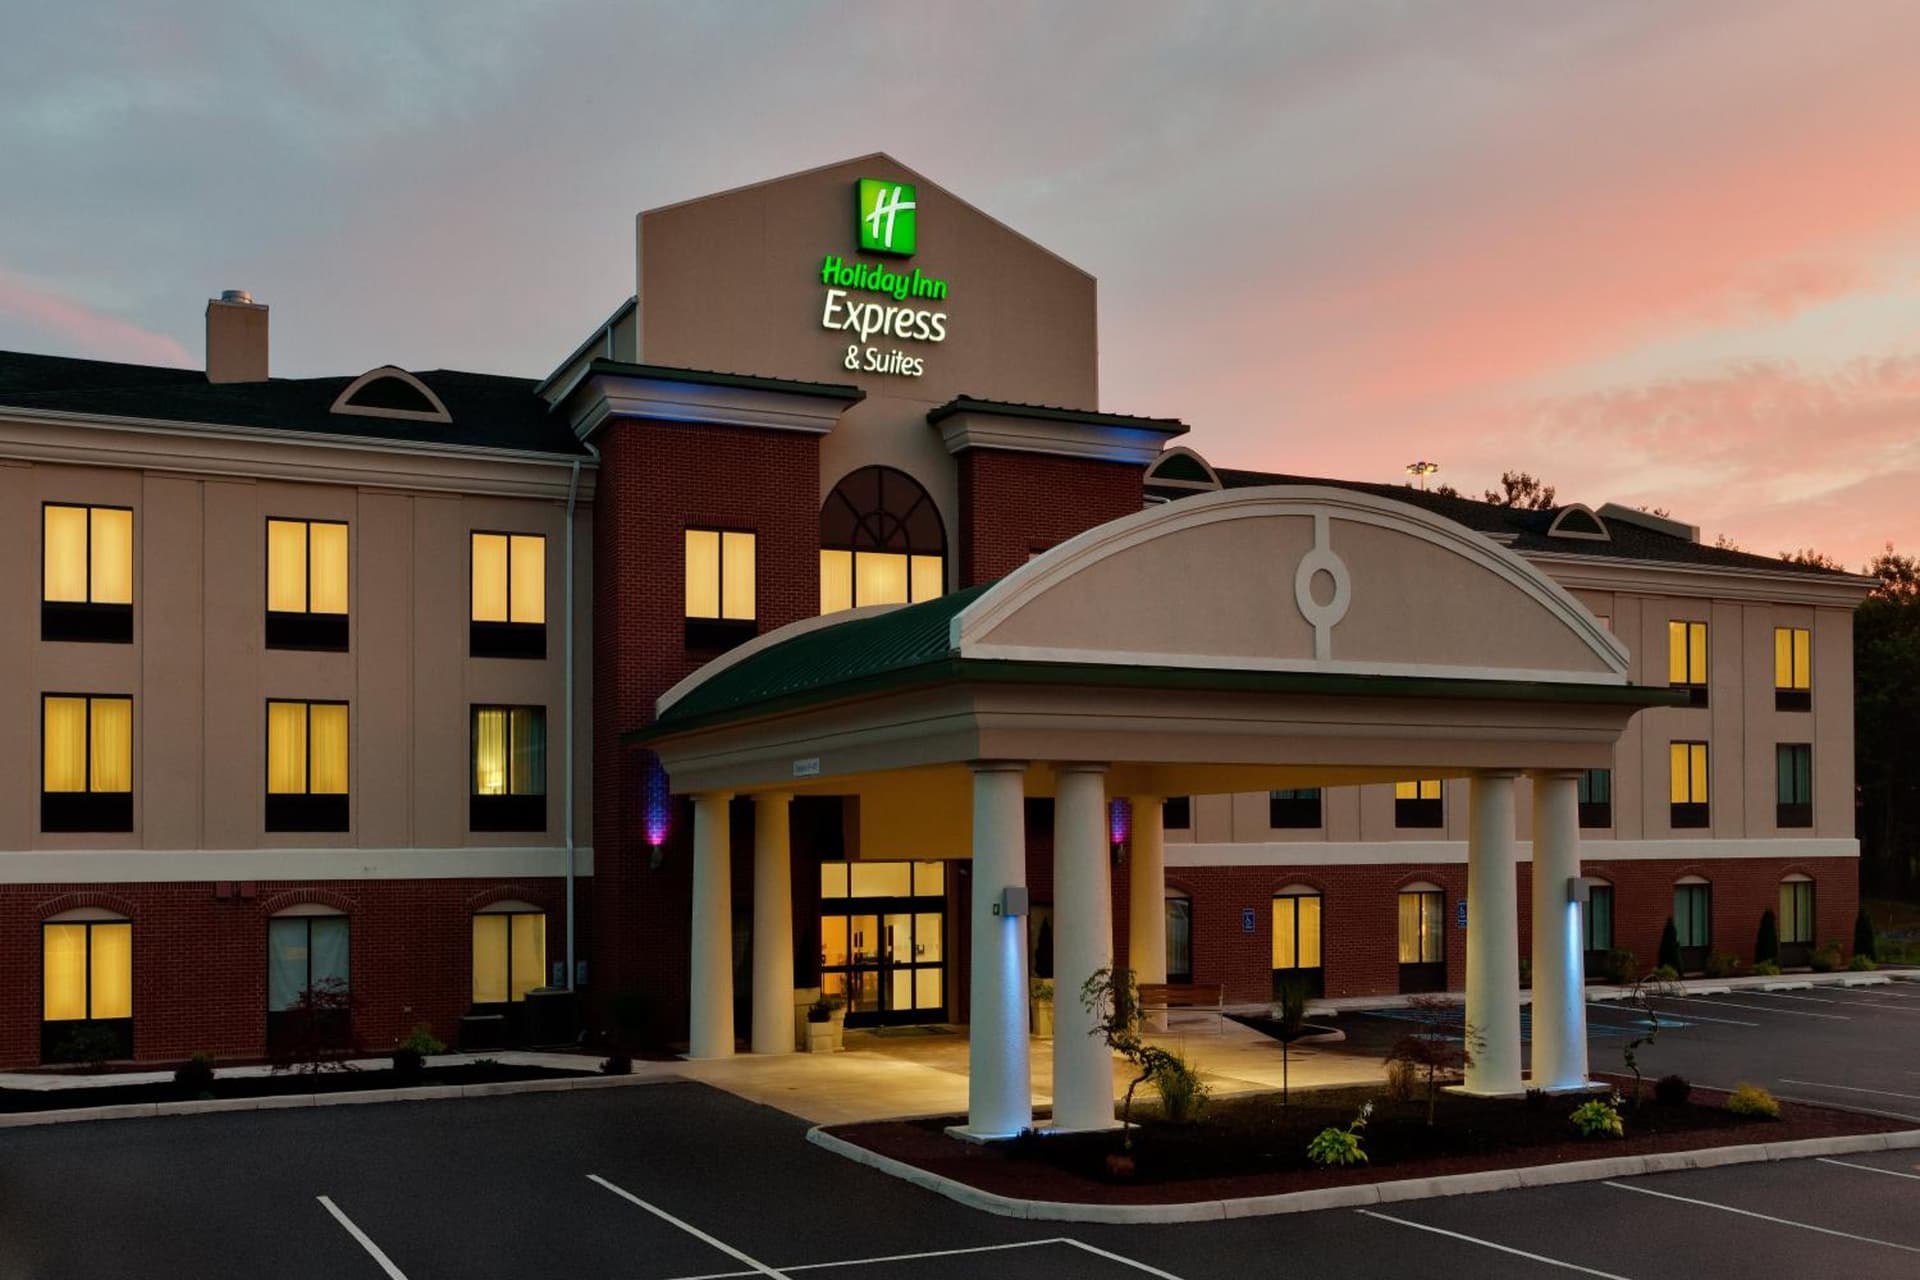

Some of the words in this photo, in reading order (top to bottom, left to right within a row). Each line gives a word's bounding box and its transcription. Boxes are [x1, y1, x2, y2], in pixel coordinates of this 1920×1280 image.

[866, 186, 916, 247] H
[821, 255, 910, 301] Holiday
[912, 268, 948, 299] Inn
[822, 289, 947, 343] Express
[845, 345, 860, 370] &
[863, 347, 924, 377] Suites
